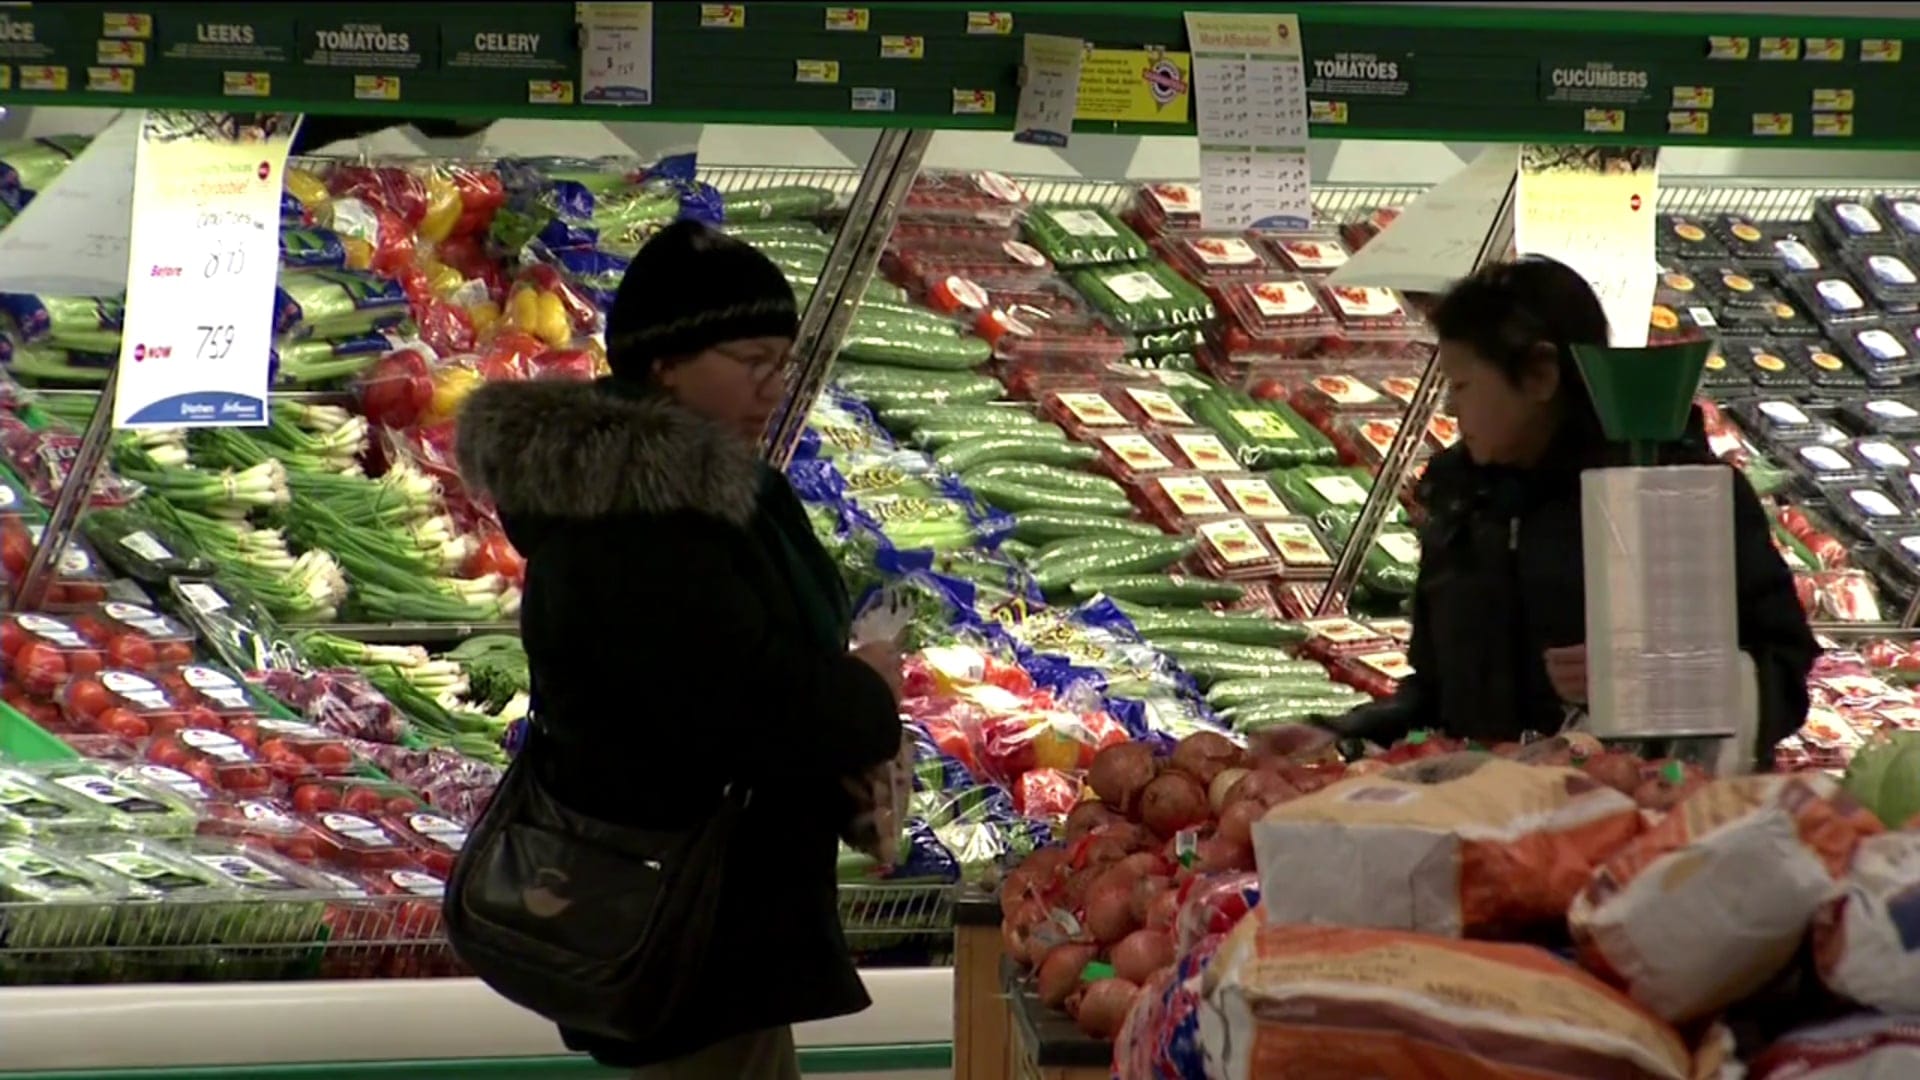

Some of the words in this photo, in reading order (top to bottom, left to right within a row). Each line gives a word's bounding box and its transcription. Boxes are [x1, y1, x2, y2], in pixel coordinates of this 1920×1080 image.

[196, 23, 255, 44] LEEKS
[315, 31, 410, 52] TOMATOES
[474, 33, 541, 53] CELERY
[1313, 60, 1399, 80] TOMATOES
[1551, 68, 1649, 89] CUCUMBERS
[150, 264, 183, 278] Before
